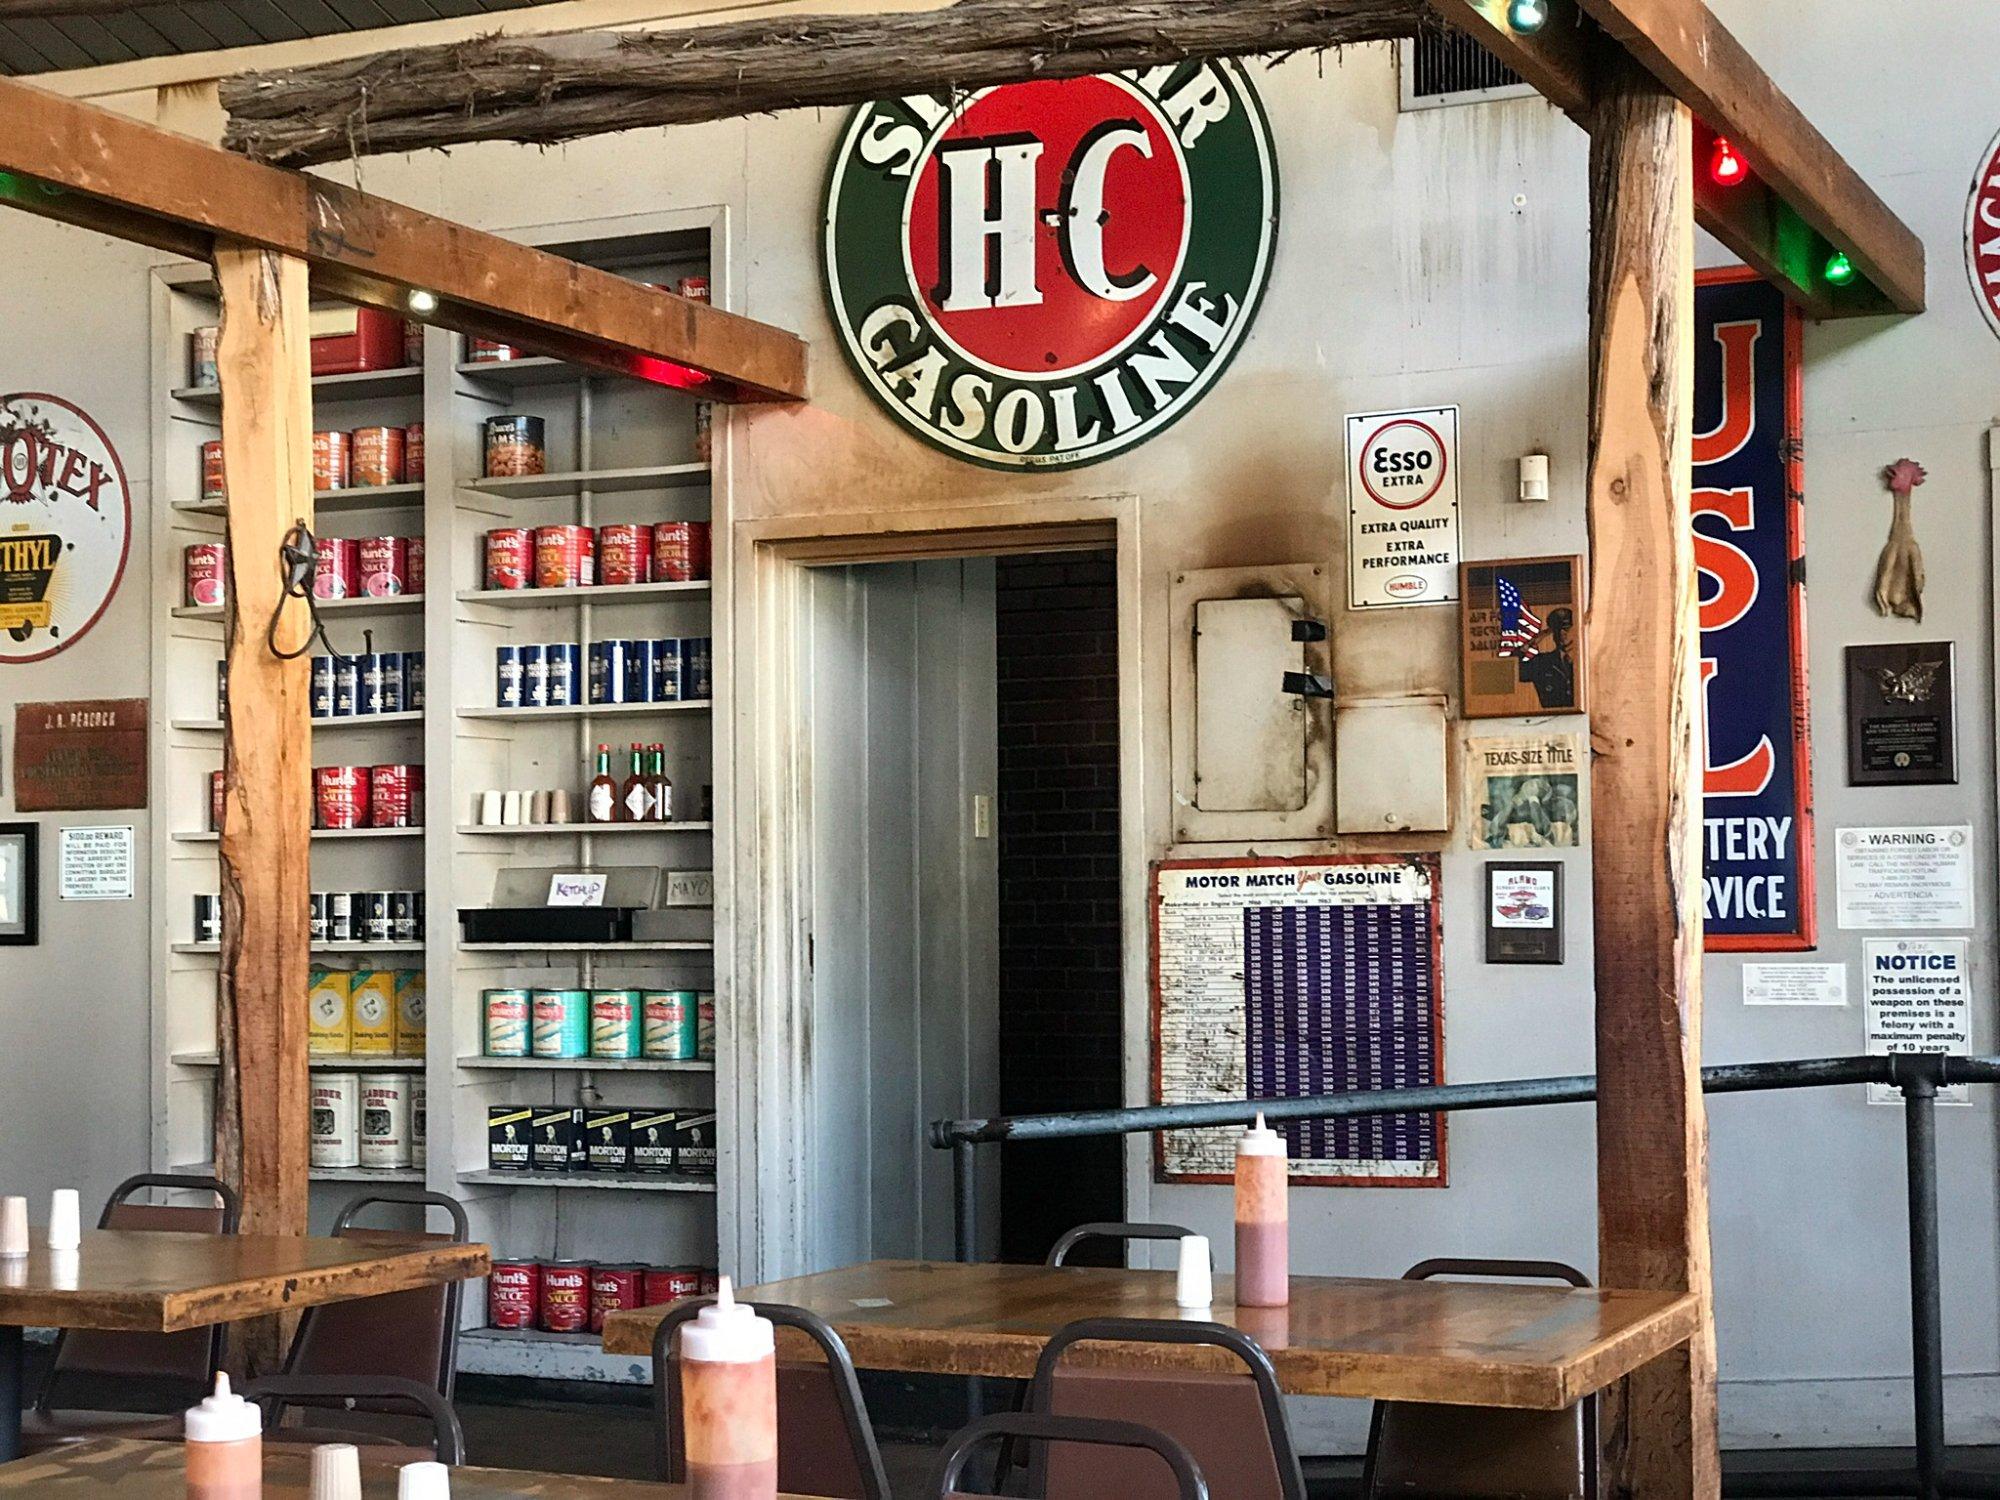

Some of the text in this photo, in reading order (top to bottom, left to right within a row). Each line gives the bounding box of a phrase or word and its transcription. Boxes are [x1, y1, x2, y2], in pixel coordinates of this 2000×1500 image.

[861, 282, 1239, 453] GASOLINE
[1383, 475, 1423, 487] EXTRA
[1361, 518, 1449, 534] EXTRA QUALITY
[656, 530, 688, 541] Hunt's
[1386, 540, 1424, 552] EXTRA
[0, 540, 55, 572] THYL
[361, 548, 392, 559] Hunt's
[1362, 553, 1450, 569] PERFORMANCE
[1389, 580, 1423, 592] HUMBLE
[70, 711, 115, 728] PEACOCK
[1484, 749, 1573, 766] TEXAS-SIZE TITLE
[321, 774, 357, 786] Hunt's
[95, 832, 123, 840] REWARD
[1704, 817, 1792, 860] TERY
[1869, 833, 1936, 845] WARNING
[1186, 876, 1240, 888] MOTOR
[1246, 874, 1295, 887] MATCH
[1324, 872, 1401, 885] GASOLINE
[556, 882, 600, 897] KETCHUP
[1874, 891, 1933, 899] ADVERTENCIA
[1702, 875, 1786, 919] RVICE
[1876, 955, 1956, 970] NOTICE
[1873, 975, 1960, 983] The unlicensed
[1872, 987, 1935, 996] possession
[1939, 987, 1951, 995] of
[1870, 1000, 1913, 1008] weapon
[1933, 998, 1964, 1006] these
[1879, 1010, 1931, 1019] premises
[1881, 1021, 1915, 1030] felony
[1871, 1032, 1965, 1042] maximum penalty
[1887, 1043, 1950, 1053] of 10 years
[367, 1099, 386, 1107] GIRL
[491, 1144, 528, 1153] MORTON
[535, 1144, 568, 1154] MORTON
[589, 1146, 626, 1155] MORTON
[634, 1147, 672, 1157] MORTON
[678, 1148, 716, 1157] MORTON
[655, 1157, 671, 1165] SALT
[493, 1272, 529, 1285] Hunt's
[546, 1274, 583, 1288] Hunt's
[493, 1291, 523, 1300] SAUCE
[547, 1294, 580, 1303] SAUCE
